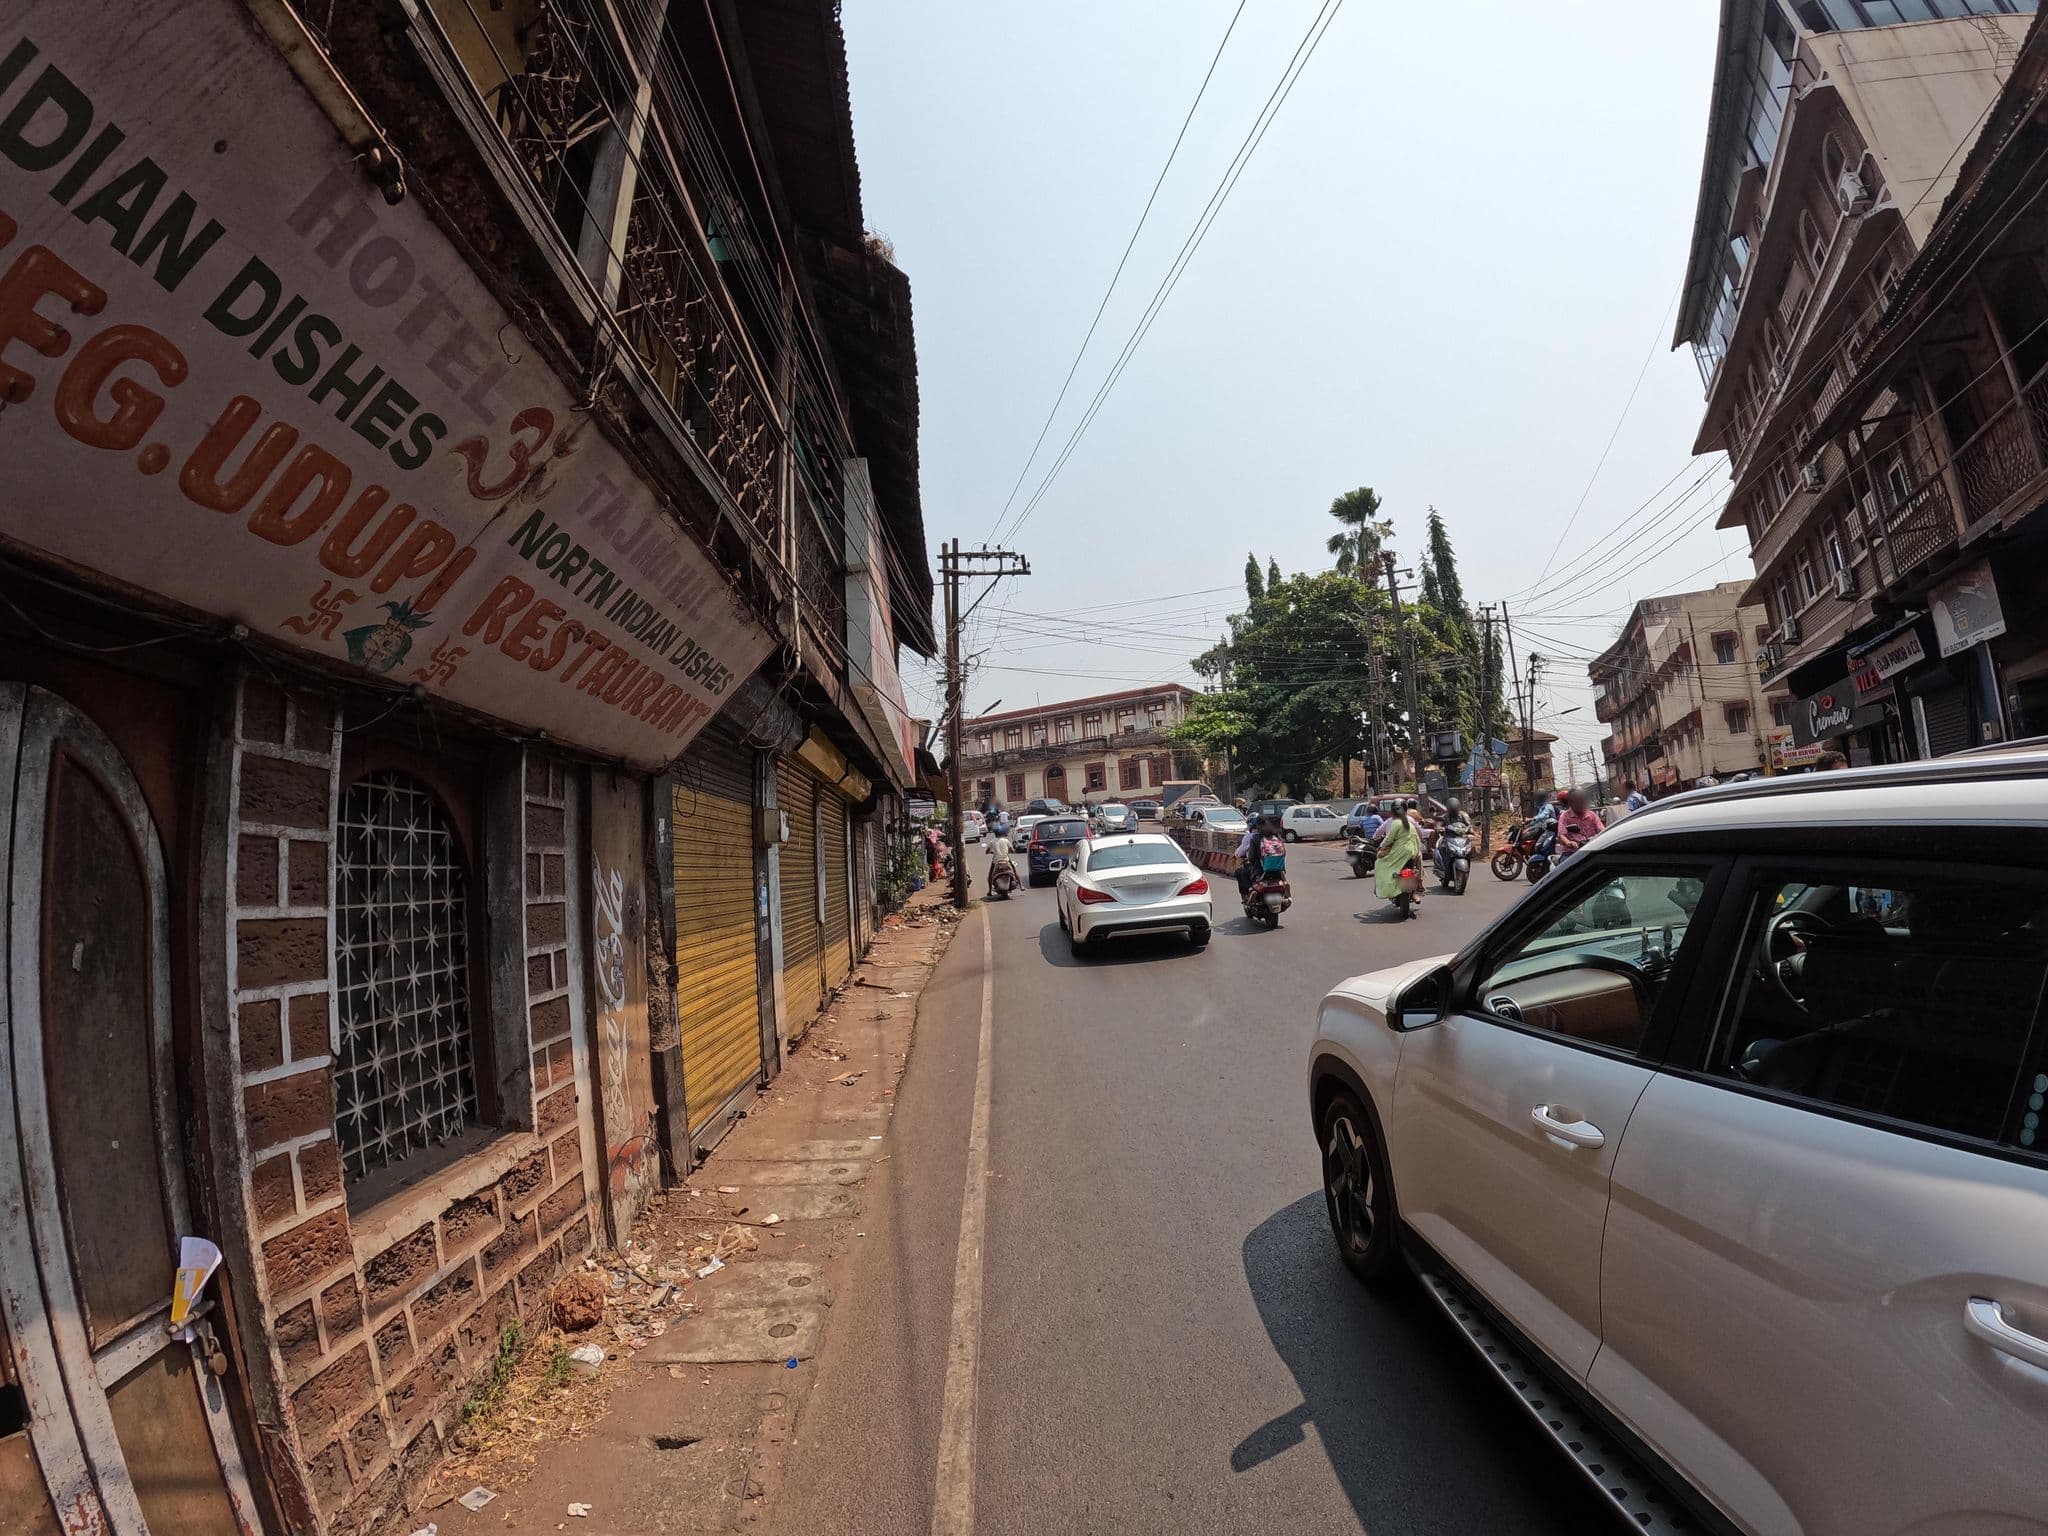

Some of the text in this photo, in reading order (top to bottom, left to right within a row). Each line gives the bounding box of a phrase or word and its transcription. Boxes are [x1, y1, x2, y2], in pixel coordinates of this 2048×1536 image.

[202, 255, 449, 471] DISHES
[286, 167, 511, 427] HOTEL
[0, 209, 188, 475] EG.
[179, 394, 478, 613] UDUPI
[462, 575, 711, 738] RESTAURANT
[605, 588, 683, 656] INDIAN
[667, 636, 735, 696] DISHES
